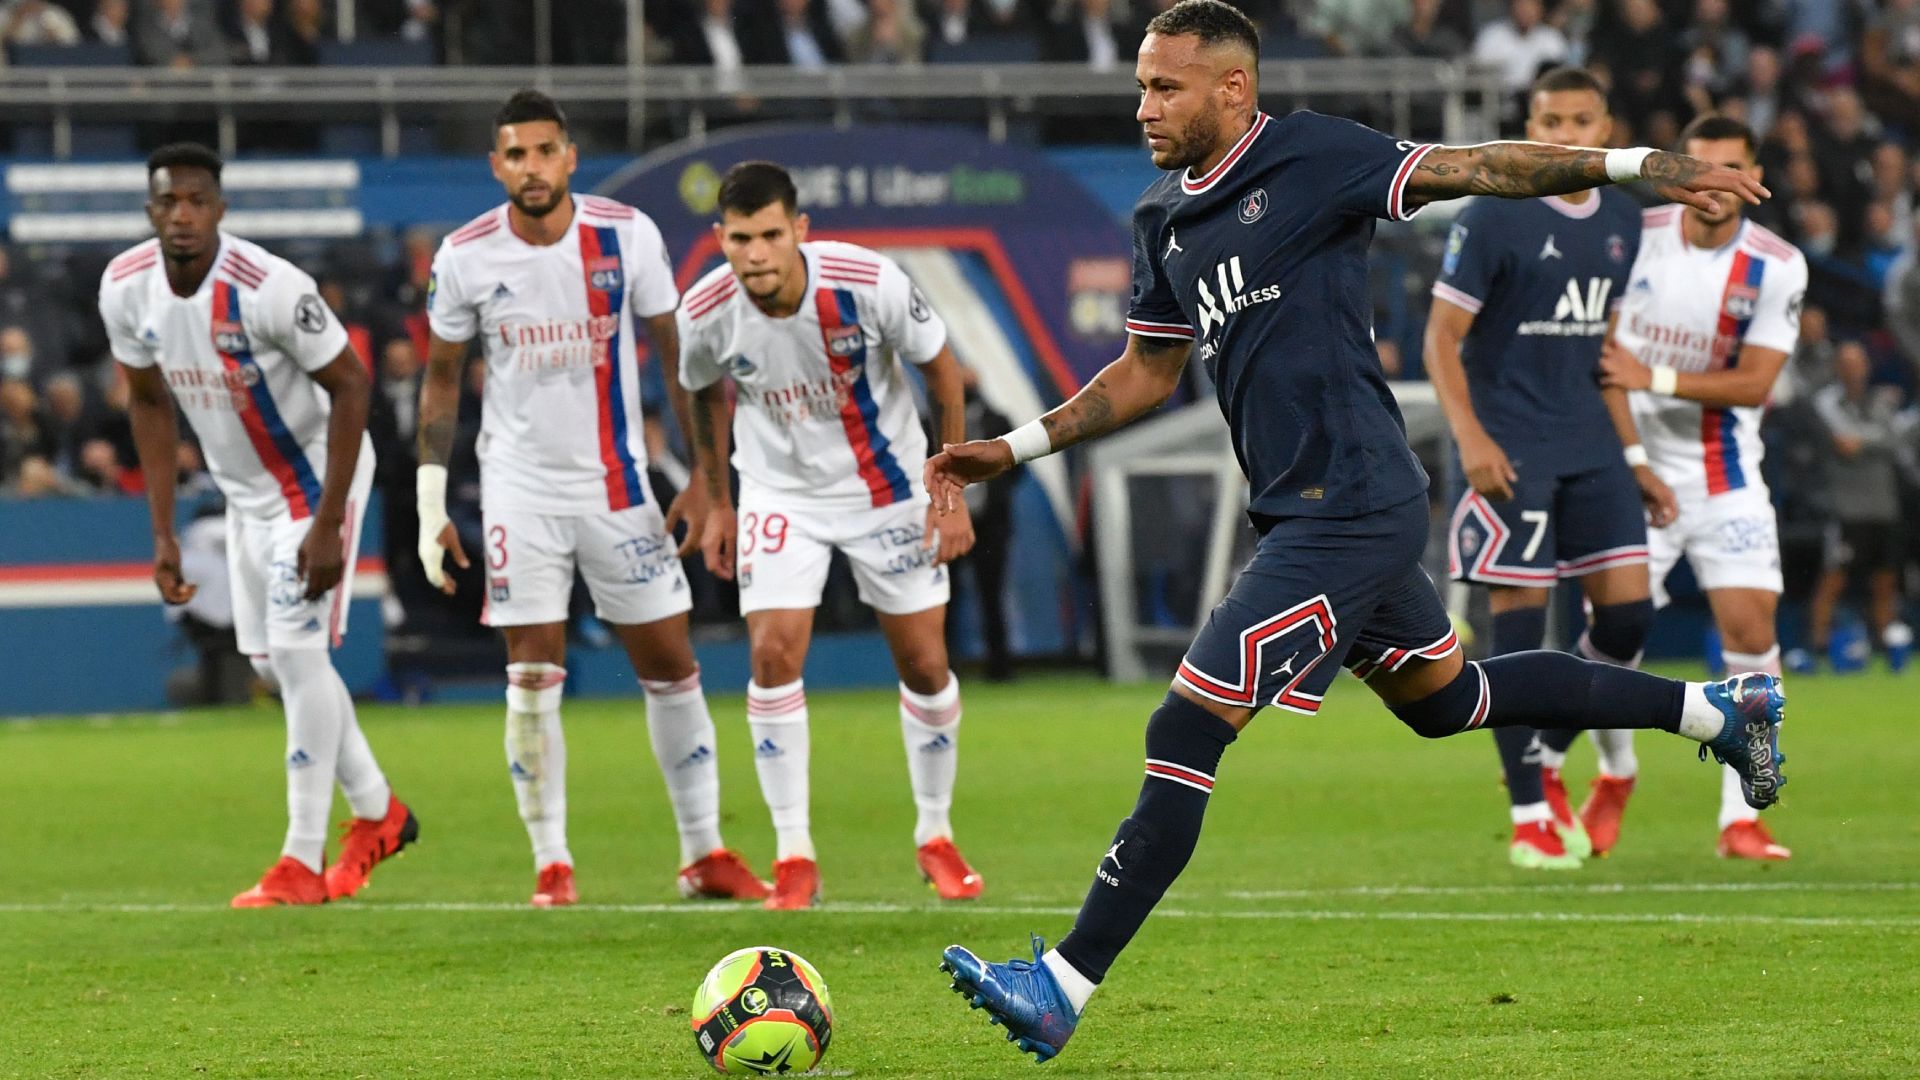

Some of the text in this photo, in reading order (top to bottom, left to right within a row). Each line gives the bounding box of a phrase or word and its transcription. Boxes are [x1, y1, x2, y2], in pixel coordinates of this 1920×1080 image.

[1228, 284, 1281, 314] ITLESS
[487, 525, 508, 571] 3
[742, 511, 789, 556] 39
[1521, 510, 1548, 561] 7
[1097, 864, 1119, 887] ARIS
[767, 949, 788, 969] ort
